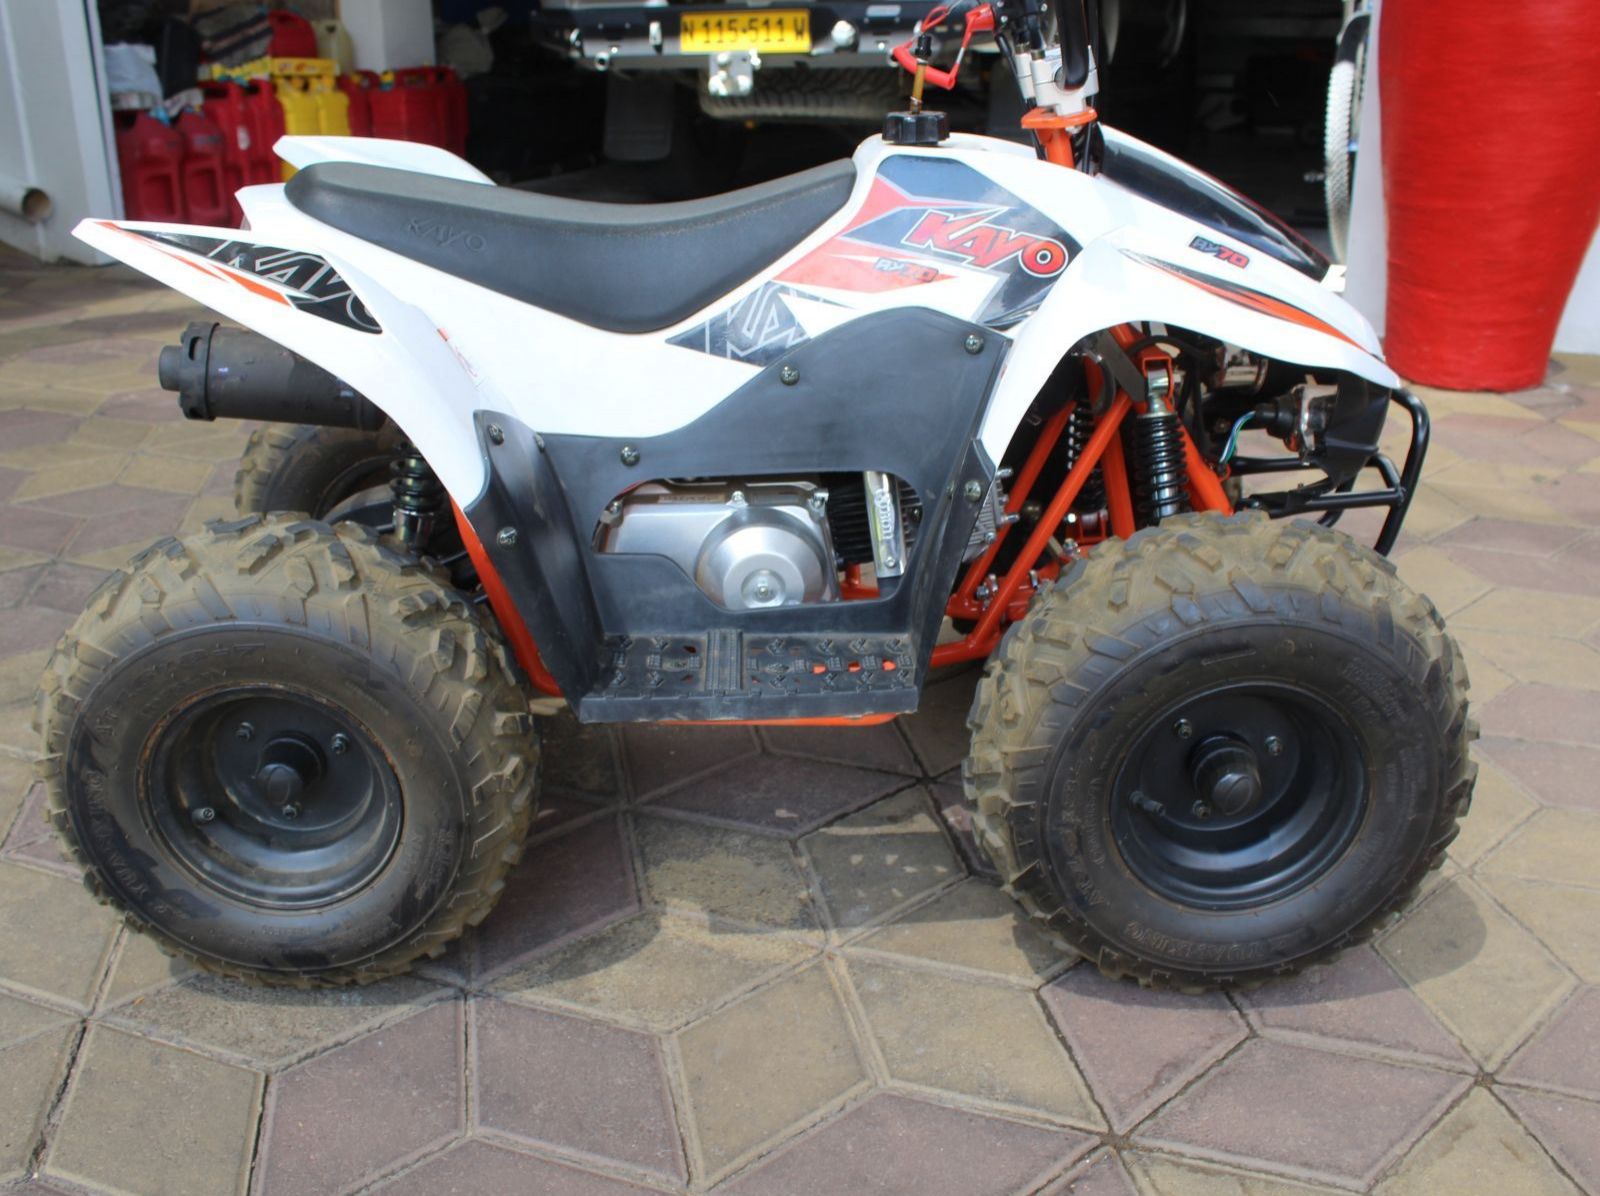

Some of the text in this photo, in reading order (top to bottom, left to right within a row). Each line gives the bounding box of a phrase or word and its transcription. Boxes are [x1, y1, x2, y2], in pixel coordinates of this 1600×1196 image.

[682, 20, 695, 41] N
[793, 17, 806, 41] W
[406, 216, 488, 254] KAYO
[901, 208, 1069, 278] KAYO
